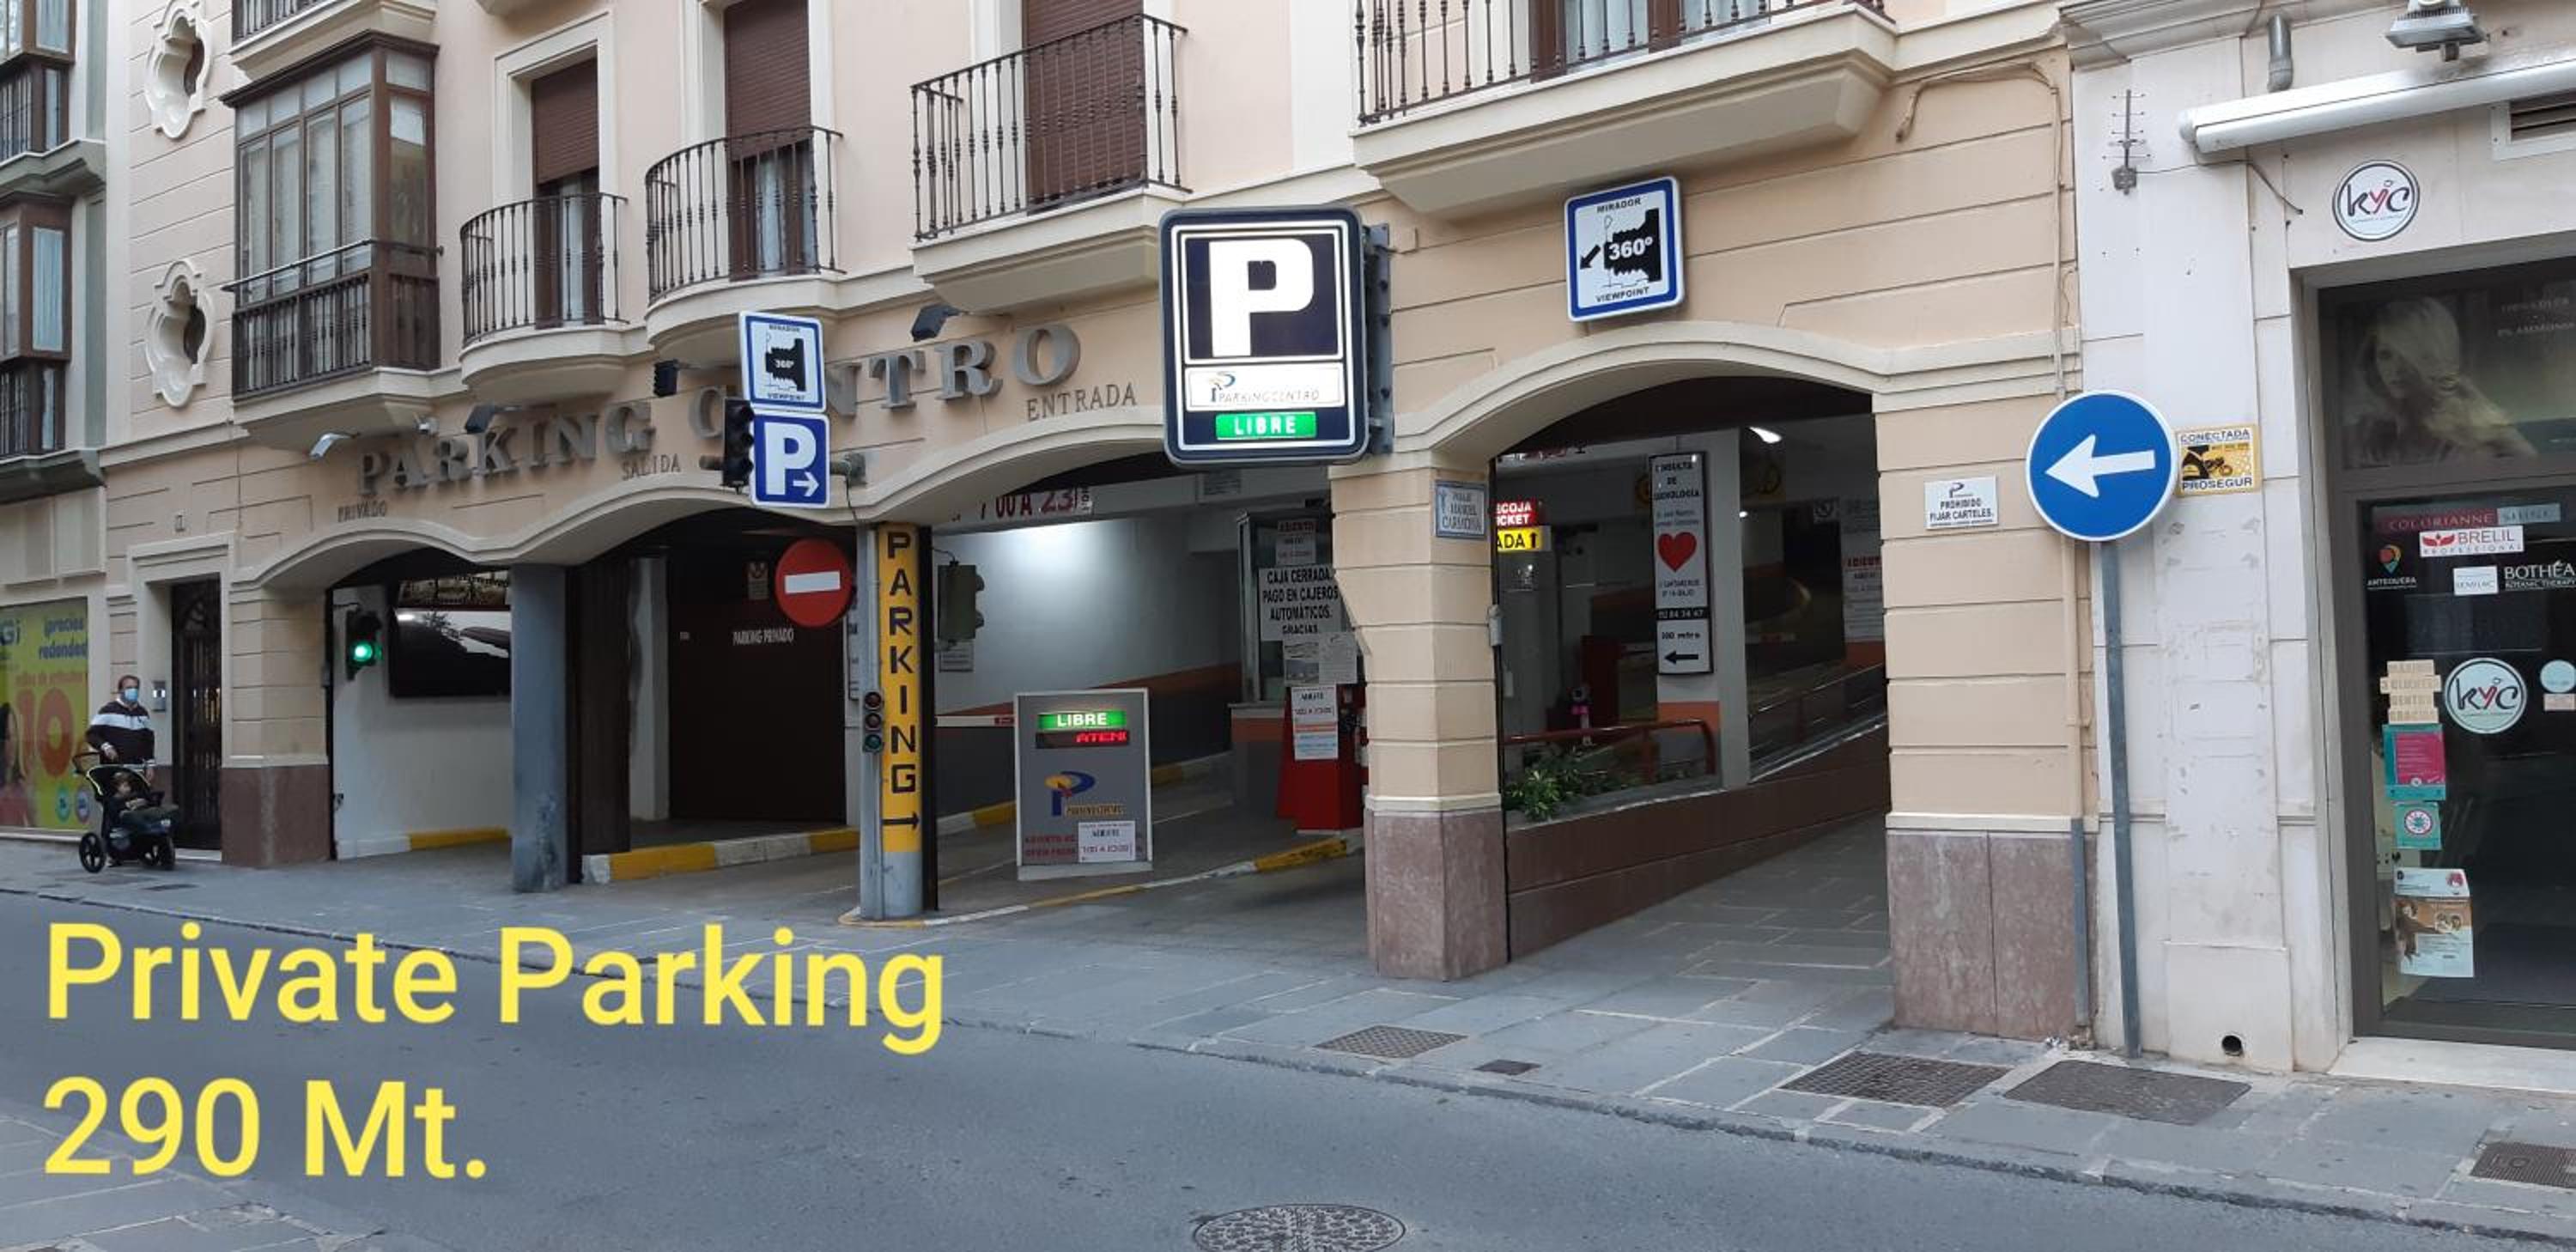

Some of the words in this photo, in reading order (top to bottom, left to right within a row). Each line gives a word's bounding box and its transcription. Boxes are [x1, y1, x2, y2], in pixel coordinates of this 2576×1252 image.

[1597, 198, 1641, 213] MIRADOR
[1208, 238, 1314, 357] P
[1595, 287, 1649, 302] VIEWPOINT
[357, 400, 657, 497] PARKING
[693, 321, 1081, 441] CNTRO
[1026, 382, 1137, 422] ENTRADA
[1234, 416, 1297, 435] LIBRE
[2181, 428, 2250, 442] CONECTADA
[622, 453, 681, 481] SALIDA
[763, 422, 817, 496] P
[2182, 477, 2252, 490] PROSEGUR
[337, 500, 386, 523] PRIVADO
[1497, 501, 1532, 514] ECOJA
[1940, 498, 1982, 509] PROHIBIDO
[1496, 514, 1530, 526] ICKET
[2458, 529, 2515, 544] BRELIL
[1267, 569, 1289, 584] CAJA
[2504, 559, 2575, 580] BOTHÉA
[1262, 588, 1285, 603] PAGO
[1287, 587, 1298, 601] EN
[1299, 586, 1339, 601] CAJEROS
[732, 629, 762, 646] PARKING
[763, 627, 794, 643] PRIVADO
[887, 531, 917, 794] PARKING
[1057, 712, 1108, 727] LIBRE
